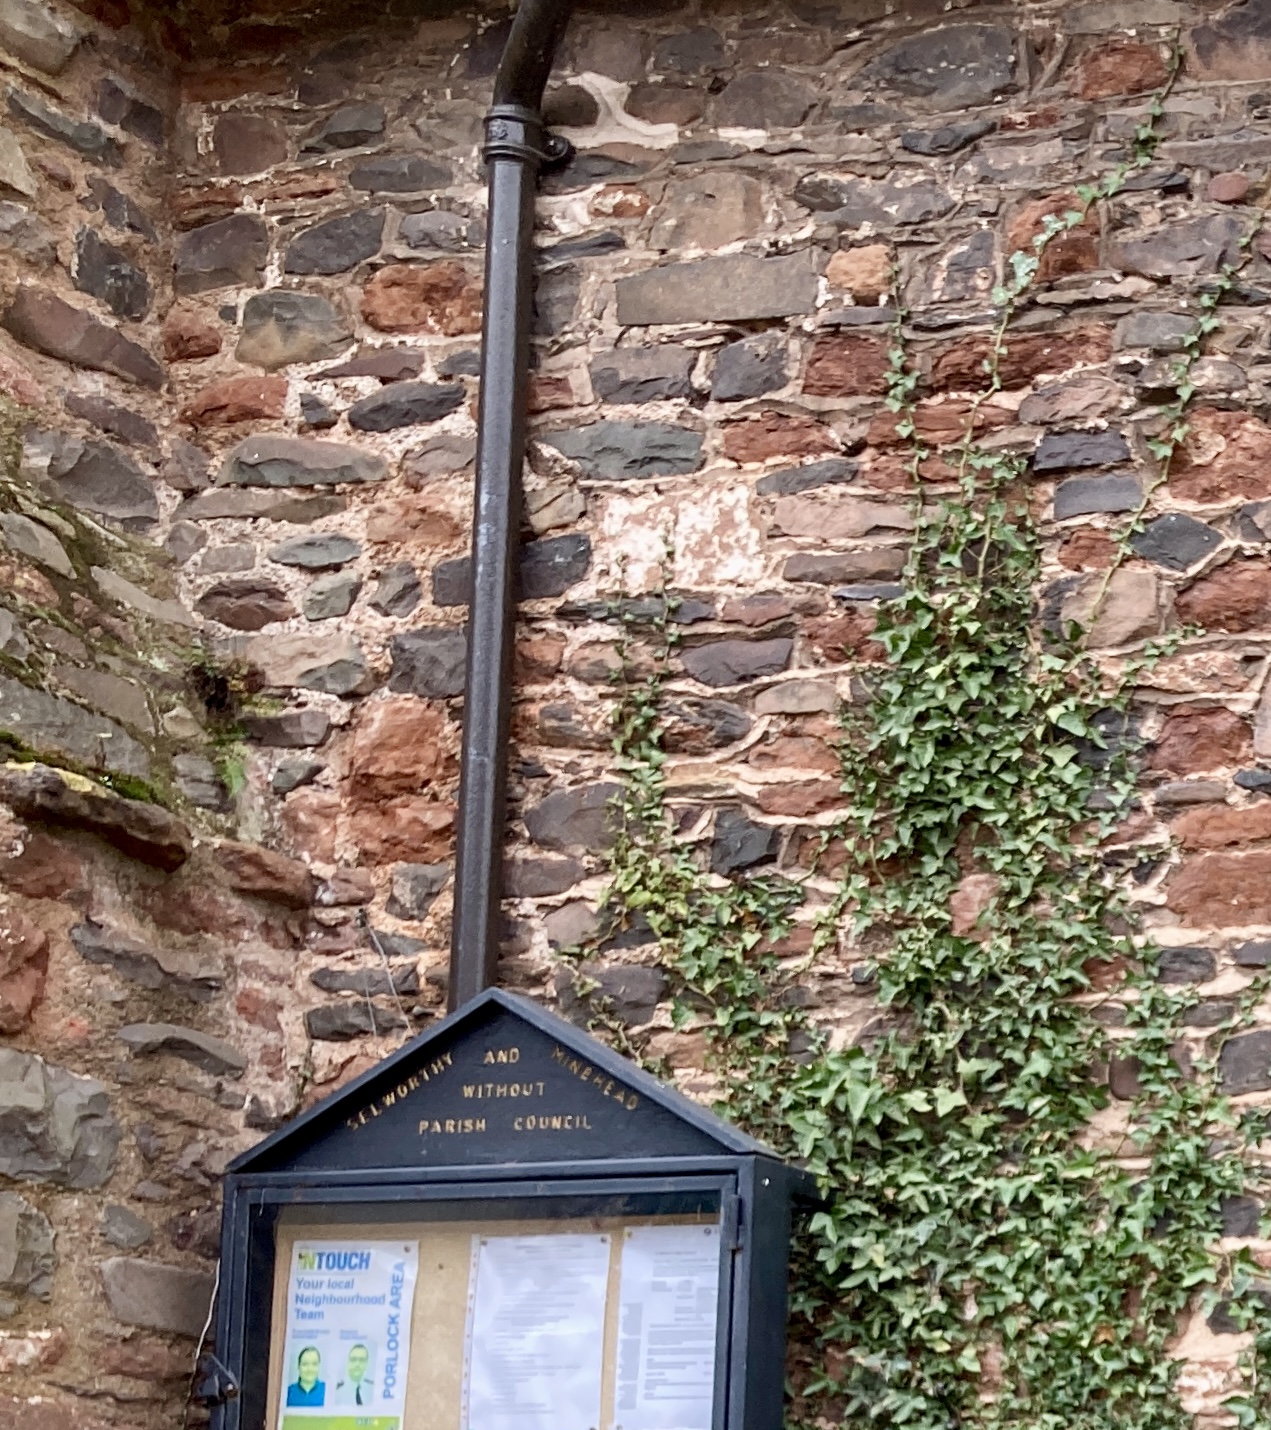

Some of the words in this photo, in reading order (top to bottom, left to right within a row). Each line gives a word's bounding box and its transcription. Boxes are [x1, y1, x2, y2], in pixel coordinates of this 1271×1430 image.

[346, 1051, 453, 1131] SELWORTHY
[483, 1047, 521, 1065] AND
[550, 1045, 640, 1111] MINEHEAD
[462, 1081, 546, 1099] WITHOUT
[418, 1118, 487, 1136] PARISH
[513, 1115, 593, 1131] COUNCIL
[296, 1277, 324, 1290] Your
[327, 1277, 355, 1290] local
[389, 1261, 406, 1309] AREA
[295, 1293, 386, 1308] Neighbourhood
[294, 1307, 325, 1320] Team
[383, 1313, 400, 1399] PORLOCK
